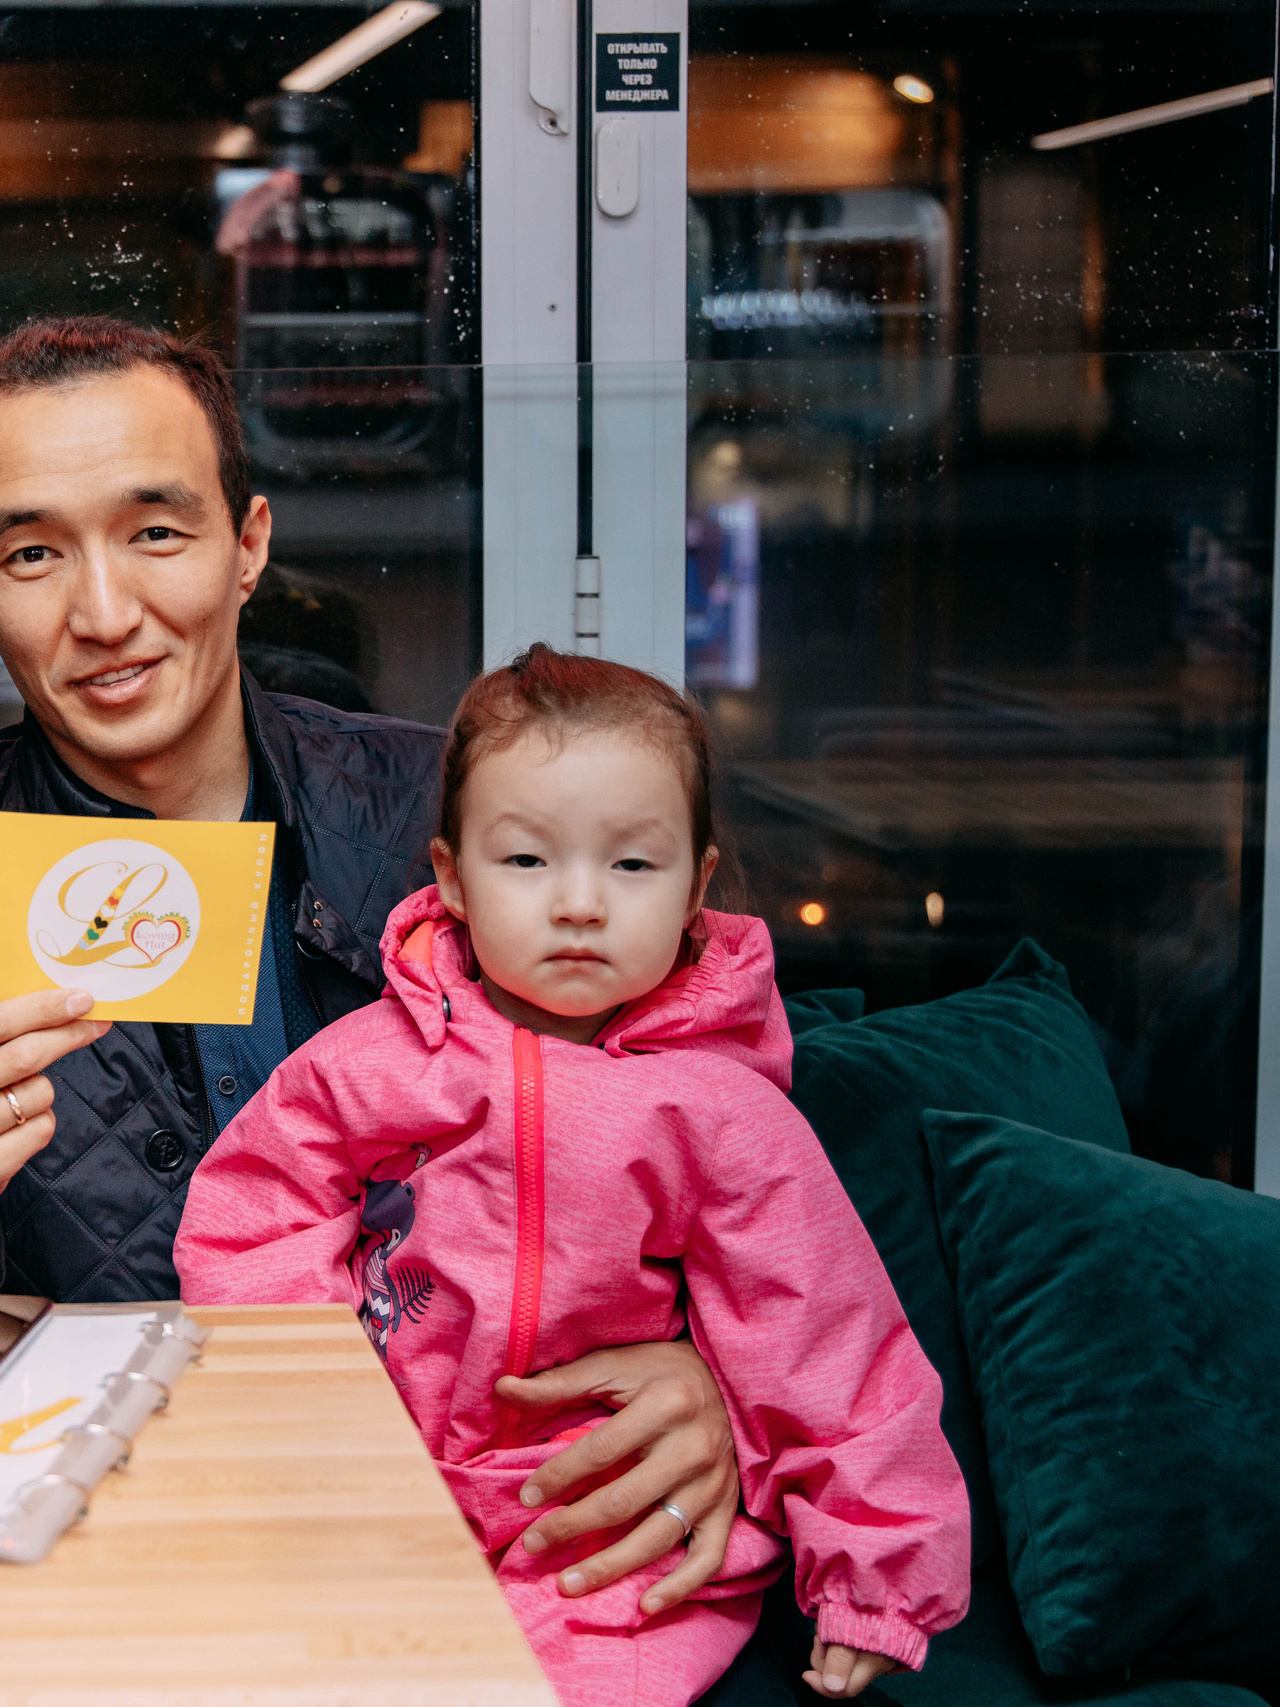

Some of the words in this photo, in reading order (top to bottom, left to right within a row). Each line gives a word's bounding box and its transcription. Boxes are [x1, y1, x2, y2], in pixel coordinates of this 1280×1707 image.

[607, 43, 668, 54] ОТКРЫВАТЬ
[617, 58, 658, 70] ТОЛЬКО
[621, 74, 653, 86] ЧЕРЕЗ
[605, 89, 669, 102] МЕНЕДЖЕРА
[237, 901, 259, 1016] ПОДАРОЧНЫЙ
[254, 833, 267, 890] КУПОН
[135, 930, 175, 942] Loving
[144, 940, 165, 949] Hut
